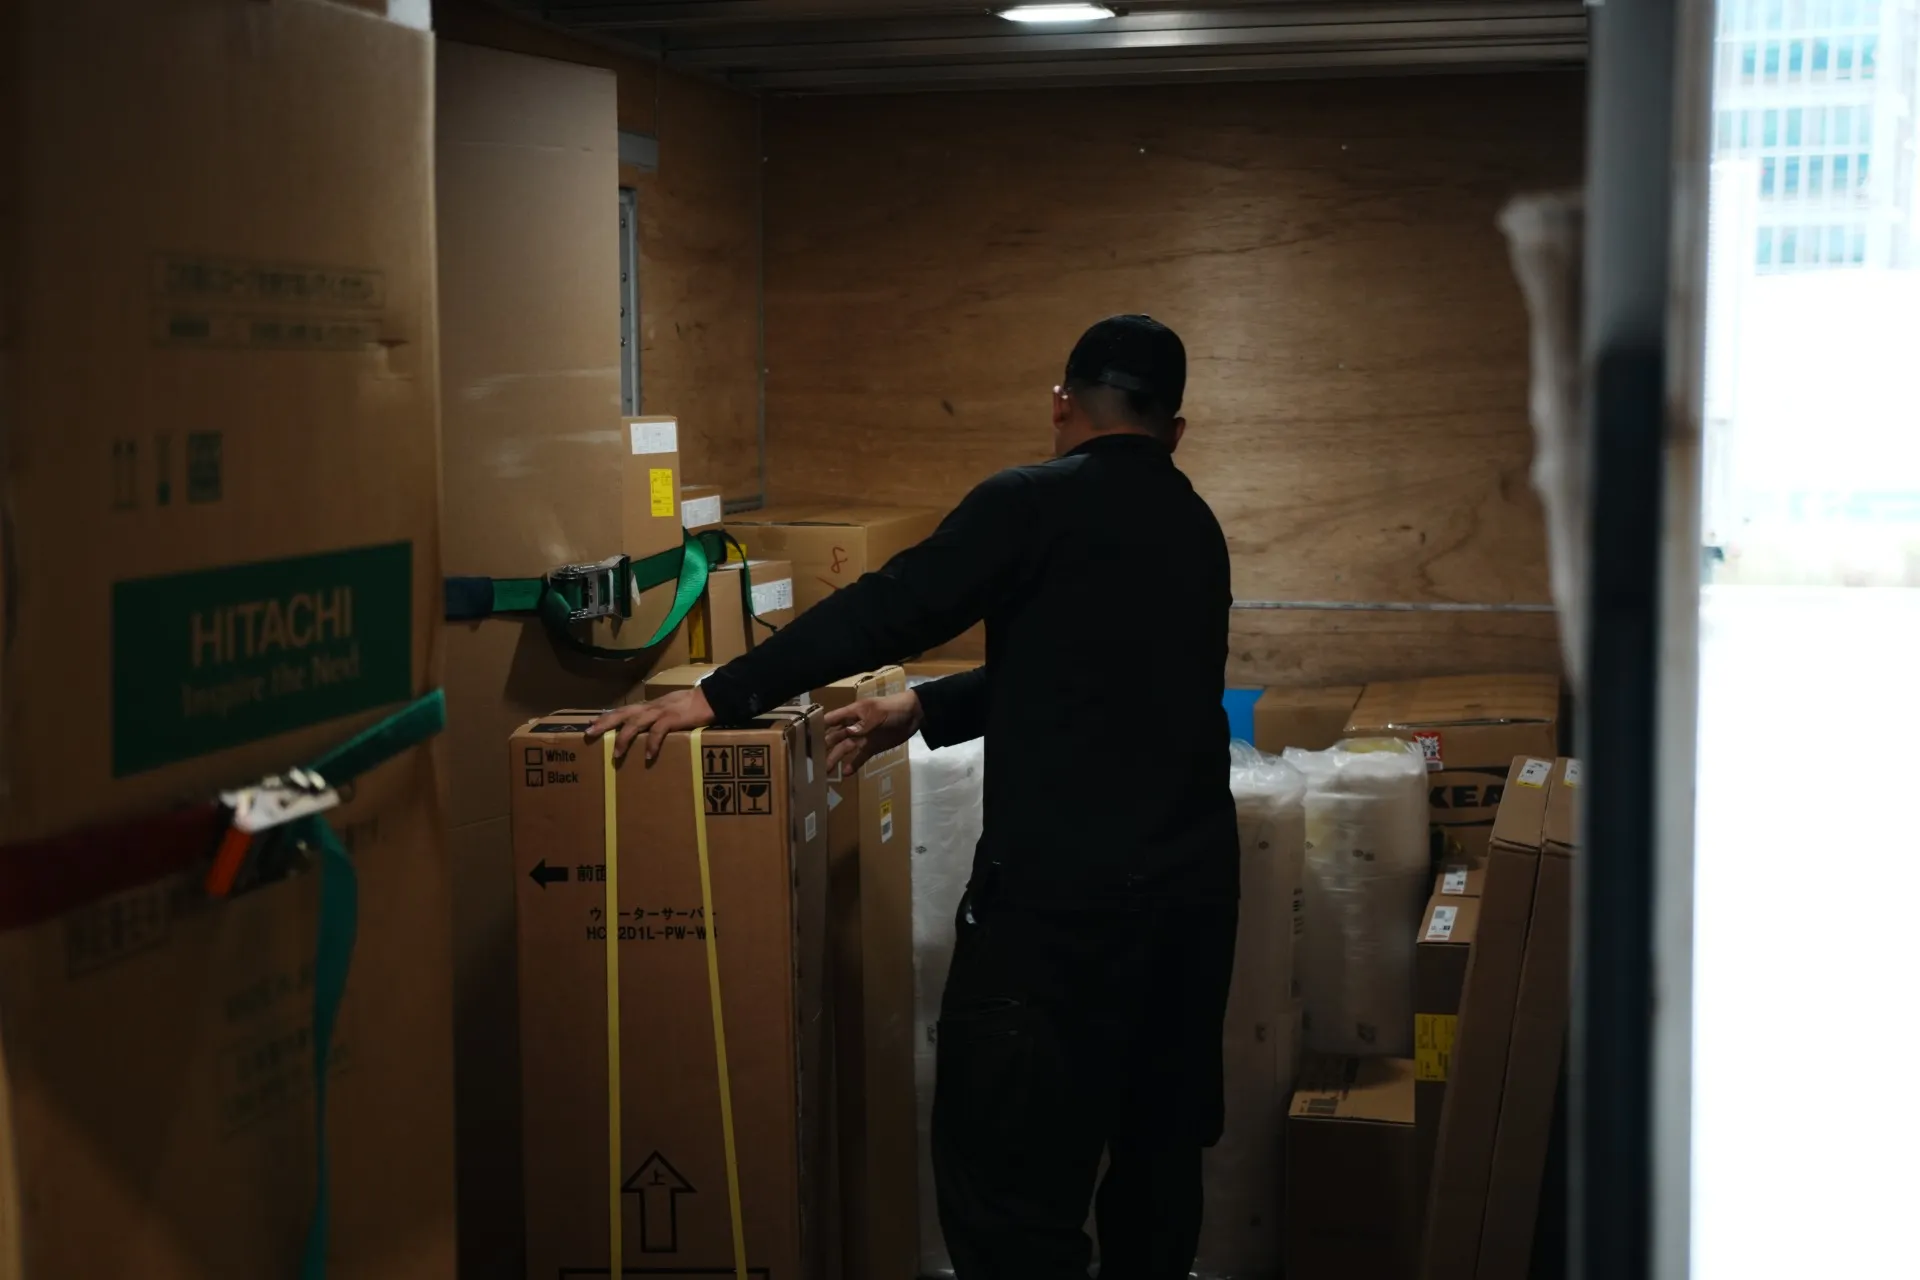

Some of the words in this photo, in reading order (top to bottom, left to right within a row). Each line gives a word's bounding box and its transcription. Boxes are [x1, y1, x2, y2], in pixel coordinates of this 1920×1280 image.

[189, 585, 355, 669] HITACHI
[545, 749, 576, 763] White
[547, 771, 579, 784] Black
[1429, 785, 1505, 808] KEA
[590, 906, 717, 921] ウーターサーバ
[586, 926, 717, 940] HC2D1L-PW-W
[647, 1170, 666, 1186] 上
